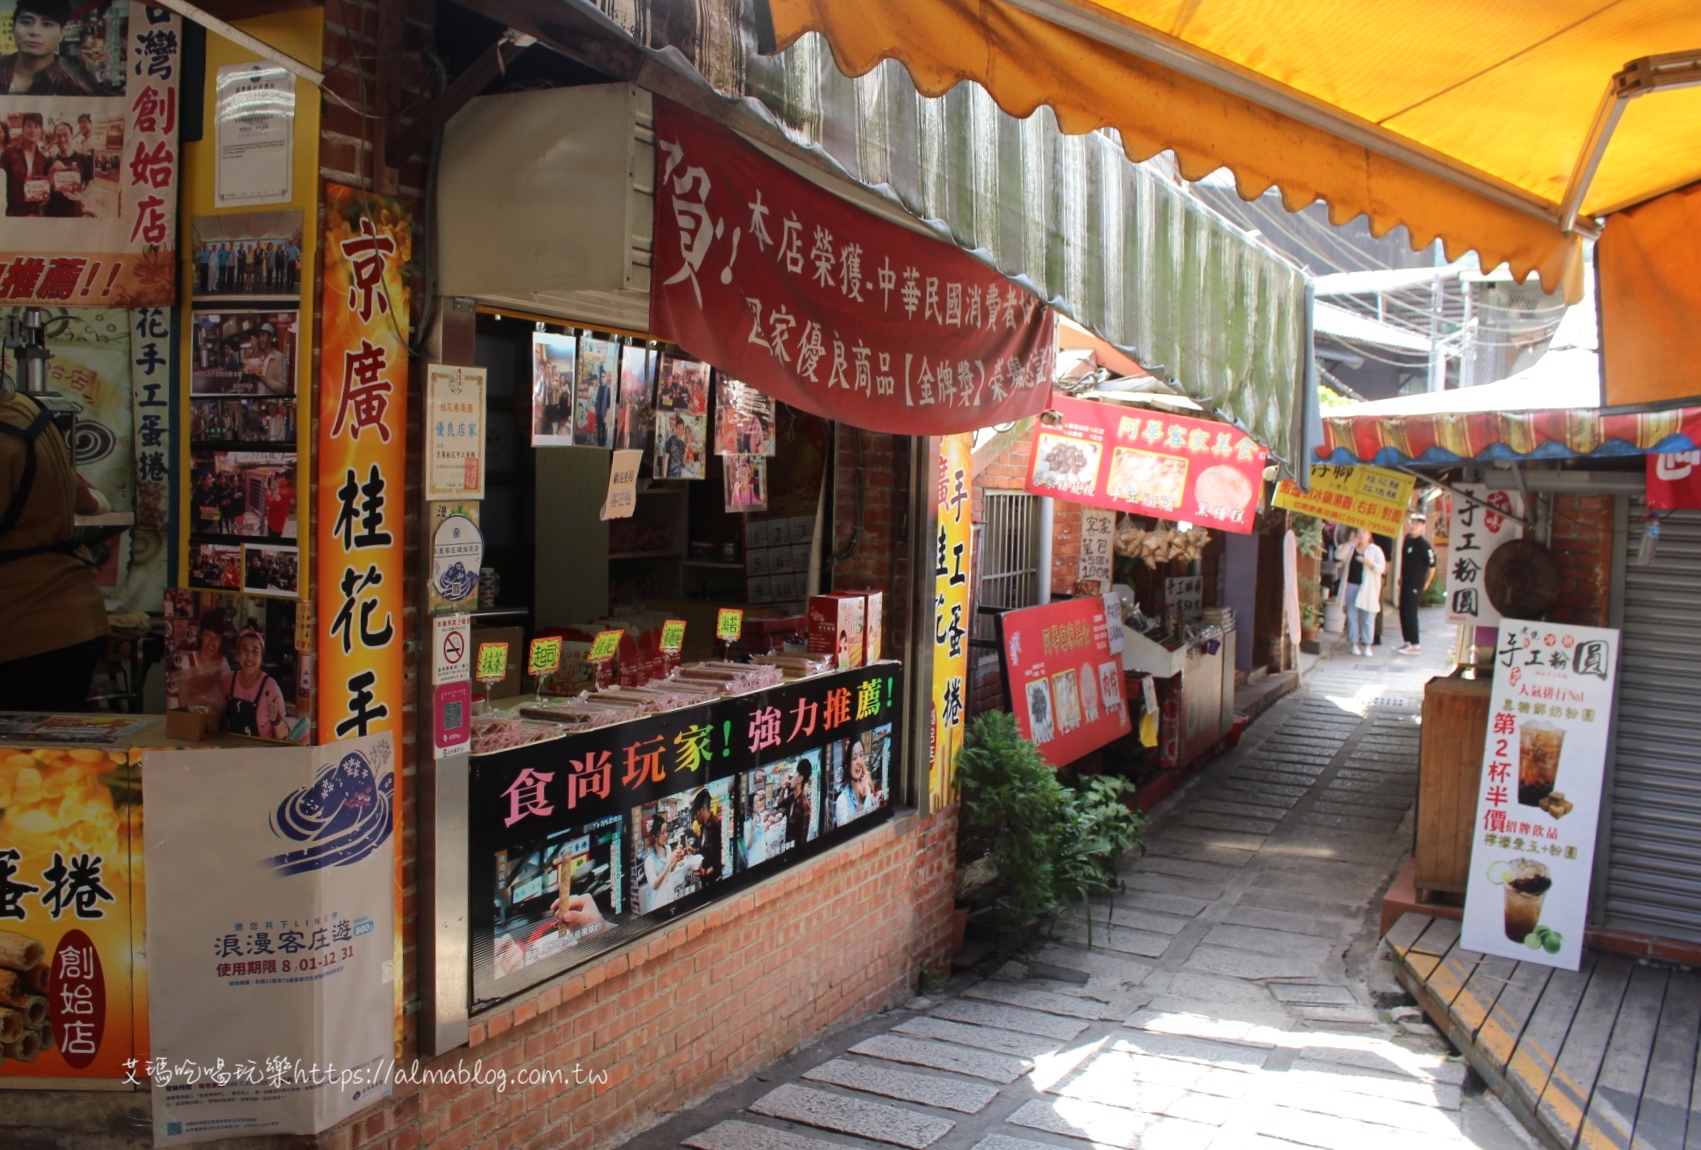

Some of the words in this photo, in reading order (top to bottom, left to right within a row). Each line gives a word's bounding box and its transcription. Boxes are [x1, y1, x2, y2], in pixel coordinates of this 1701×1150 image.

[0, 257, 122, 300] 推薦!!
[135, 307, 169, 483] 花手工蛋捲
[435, 421, 477, 437] 優良店家
[1117, 416, 1259, 461] 阿華客家美食
[331, 218, 395, 737] 京廣桂花手
[1086, 515, 1111, 534] 客家
[1452, 489, 1482, 617] 手工粉圓
[942, 470, 969, 728] 手工蛋捲
[720, 615, 737, 633] 海苔
[483, 652, 503, 674] 抹茶
[533, 644, 557, 668] 起司
[594, 637, 616, 655] 桂花
[1498, 632, 1609, 681] 手工粉圓
[500, 720, 731, 828] 食尚玩家!
[747, 677, 894, 753] 強力推薦!
[1483, 712, 1516, 833] 第2杯半價
[1505, 820, 1559, 840] 招牌飲品
[213, 919, 353, 958] 浪漫客庄遊
[216, 959, 277, 977] 使用期限
[58, 944, 97, 1056] 創始店
